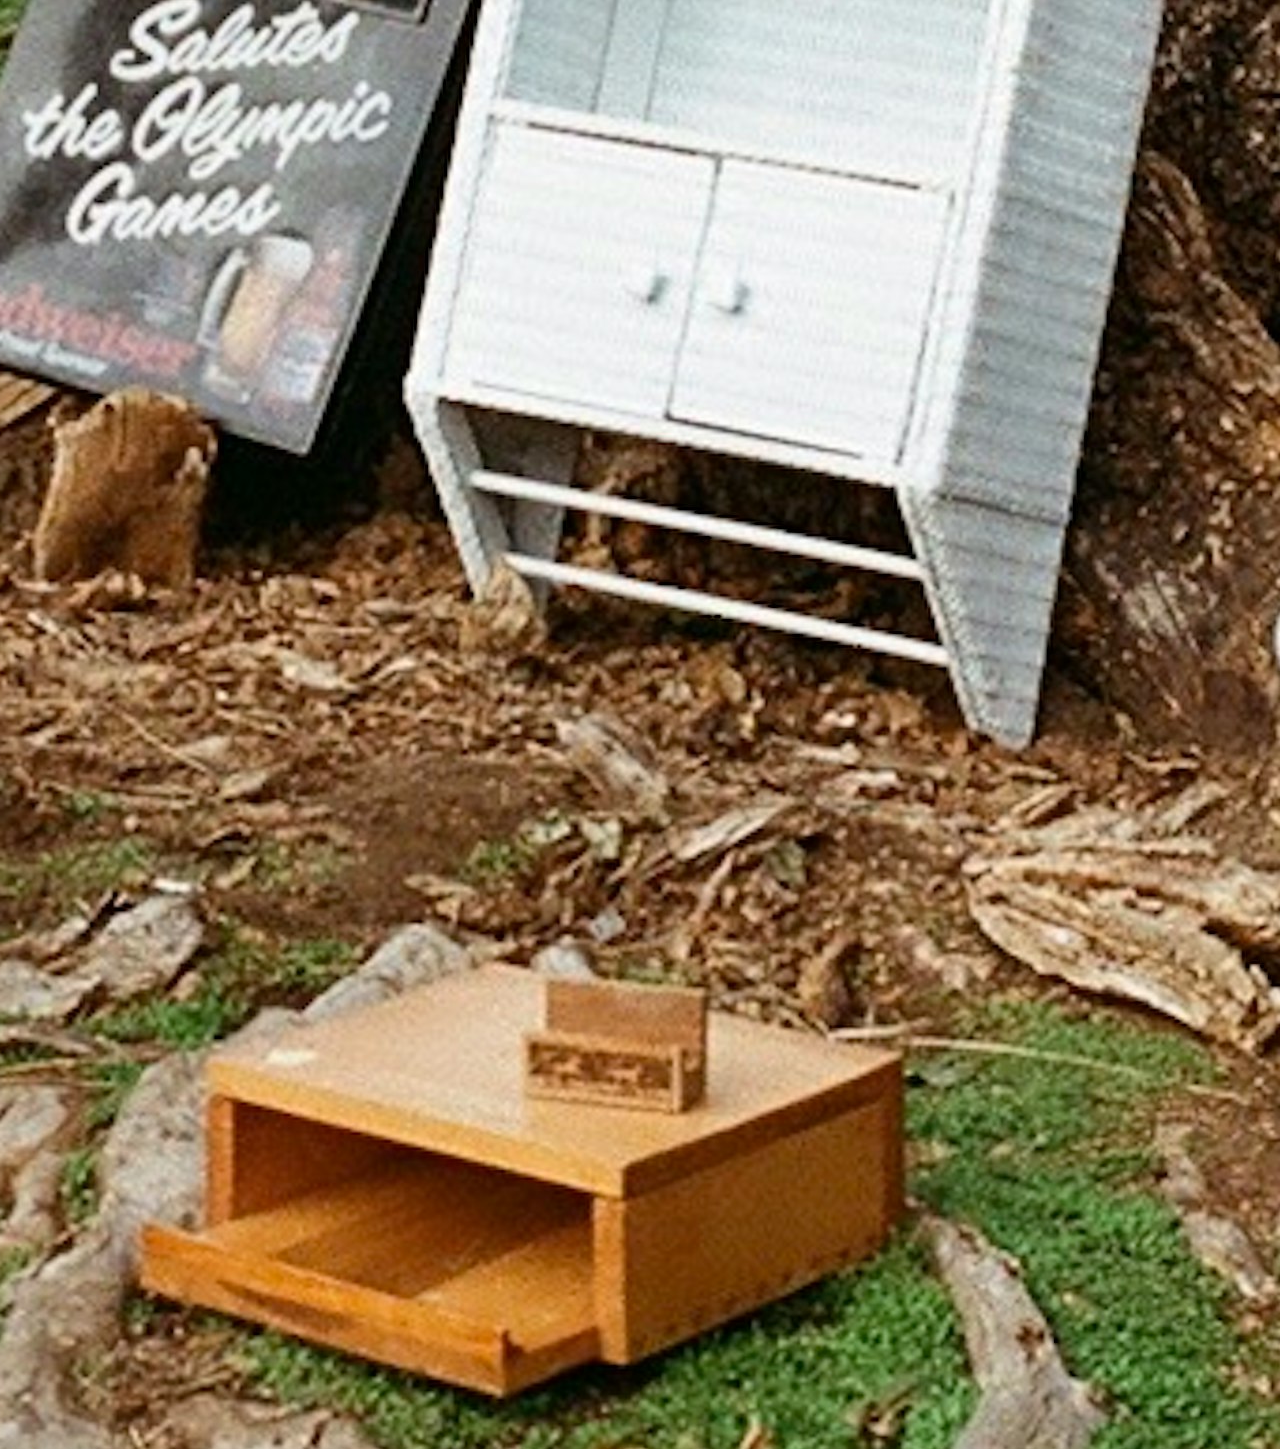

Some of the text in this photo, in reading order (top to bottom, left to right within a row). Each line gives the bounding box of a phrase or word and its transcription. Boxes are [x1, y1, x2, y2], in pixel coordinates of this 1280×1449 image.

[22, 76, 393, 181] the Olympic
[64, 161, 282, 245] Games
